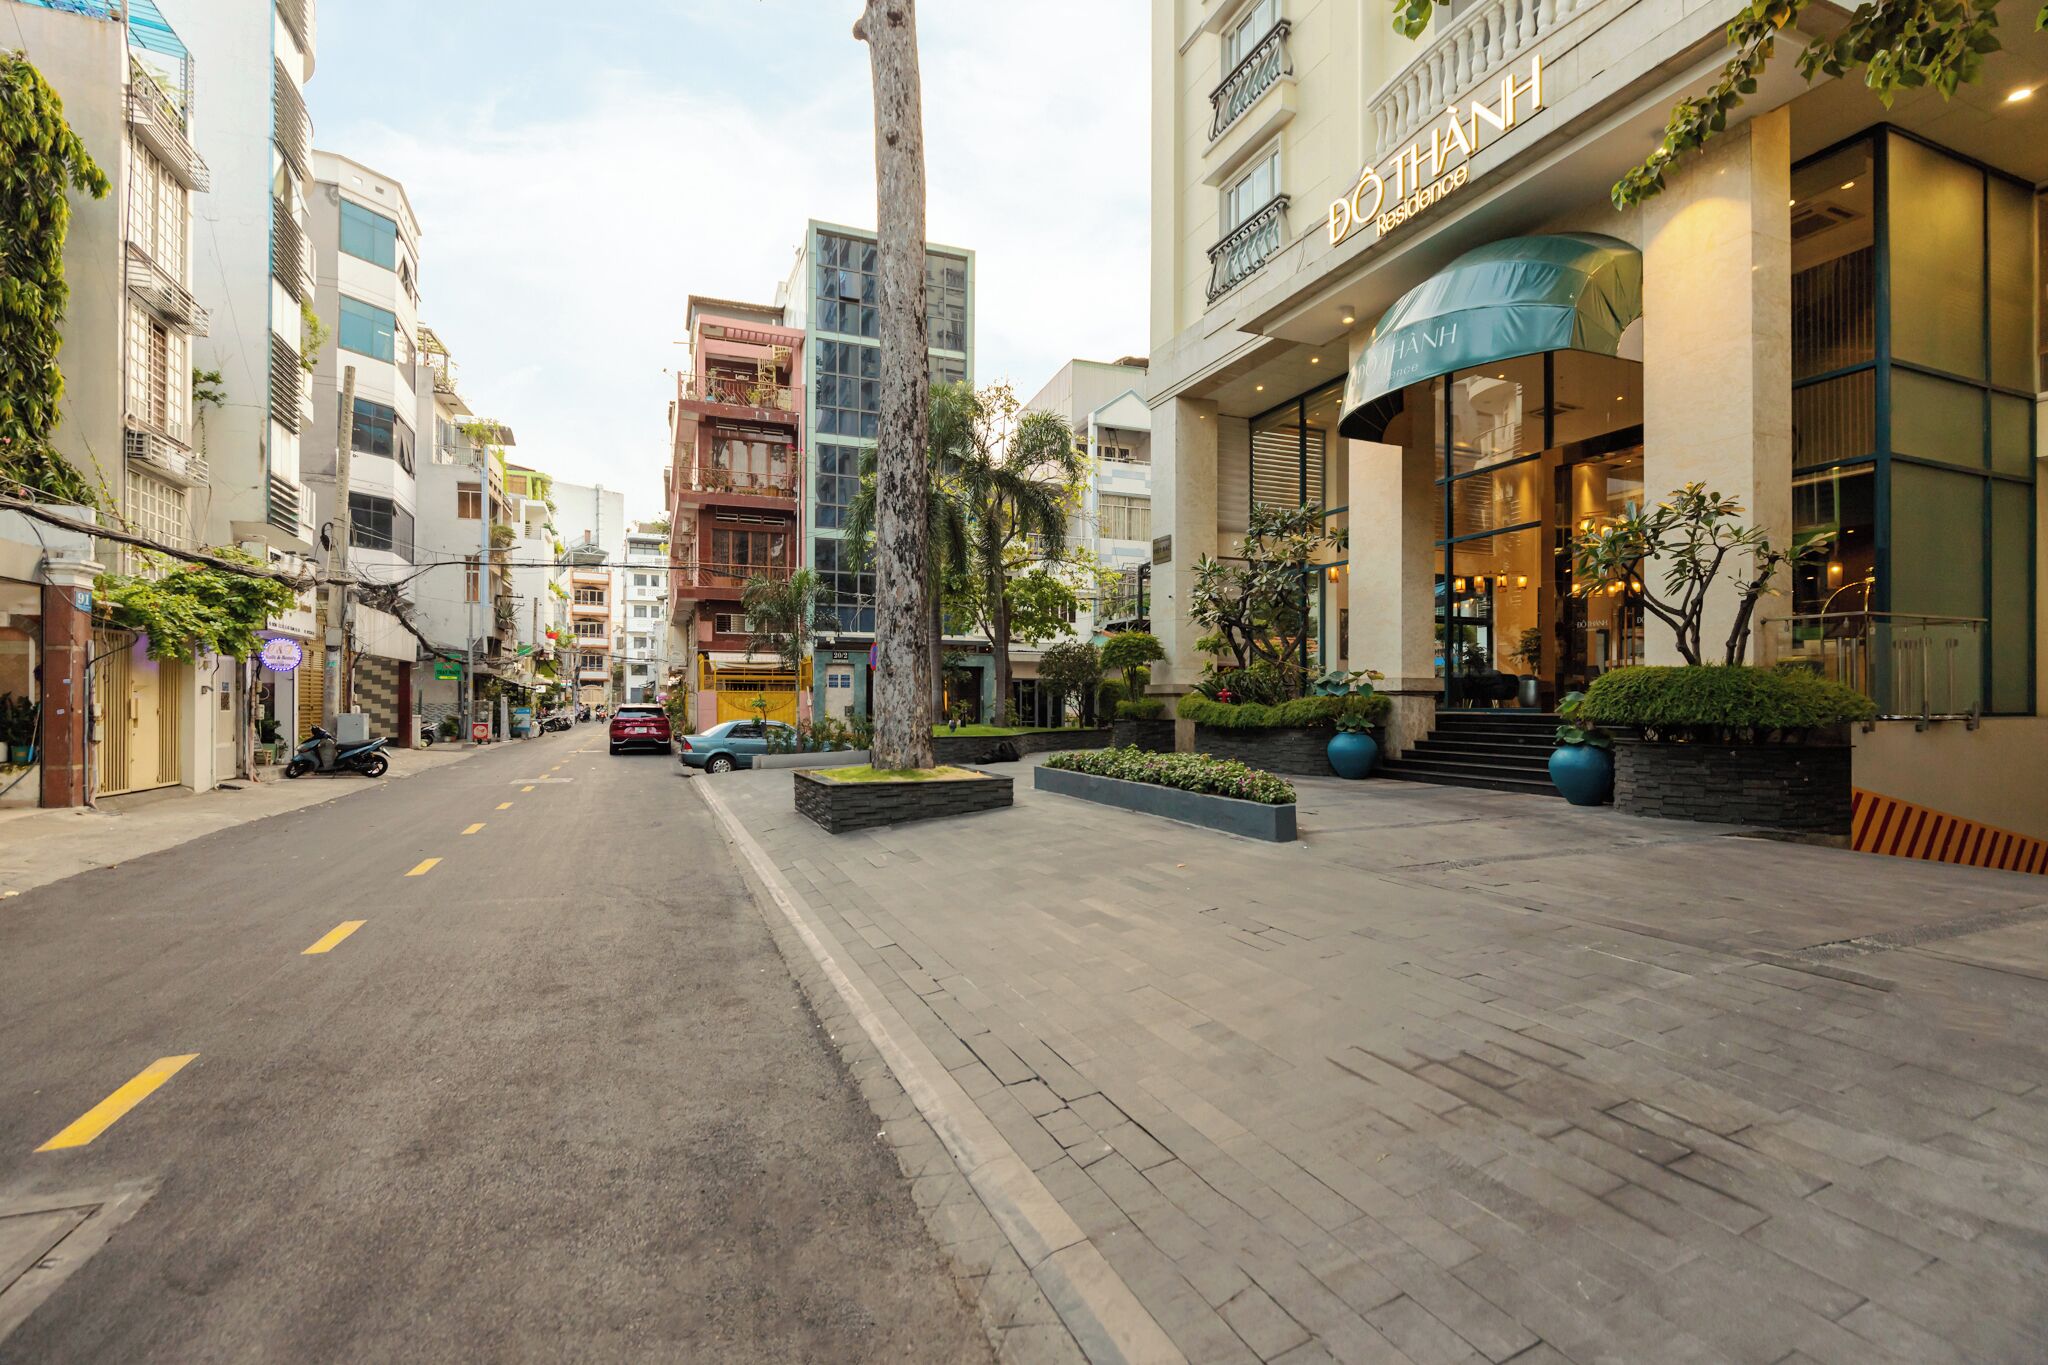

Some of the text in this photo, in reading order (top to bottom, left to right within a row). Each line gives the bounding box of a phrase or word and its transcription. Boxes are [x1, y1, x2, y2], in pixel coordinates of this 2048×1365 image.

[1327, 54, 1544, 246] ĐÔ THÀNH
[1376, 165, 1471, 238] Residence
[77, 592, 90, 606] 91
